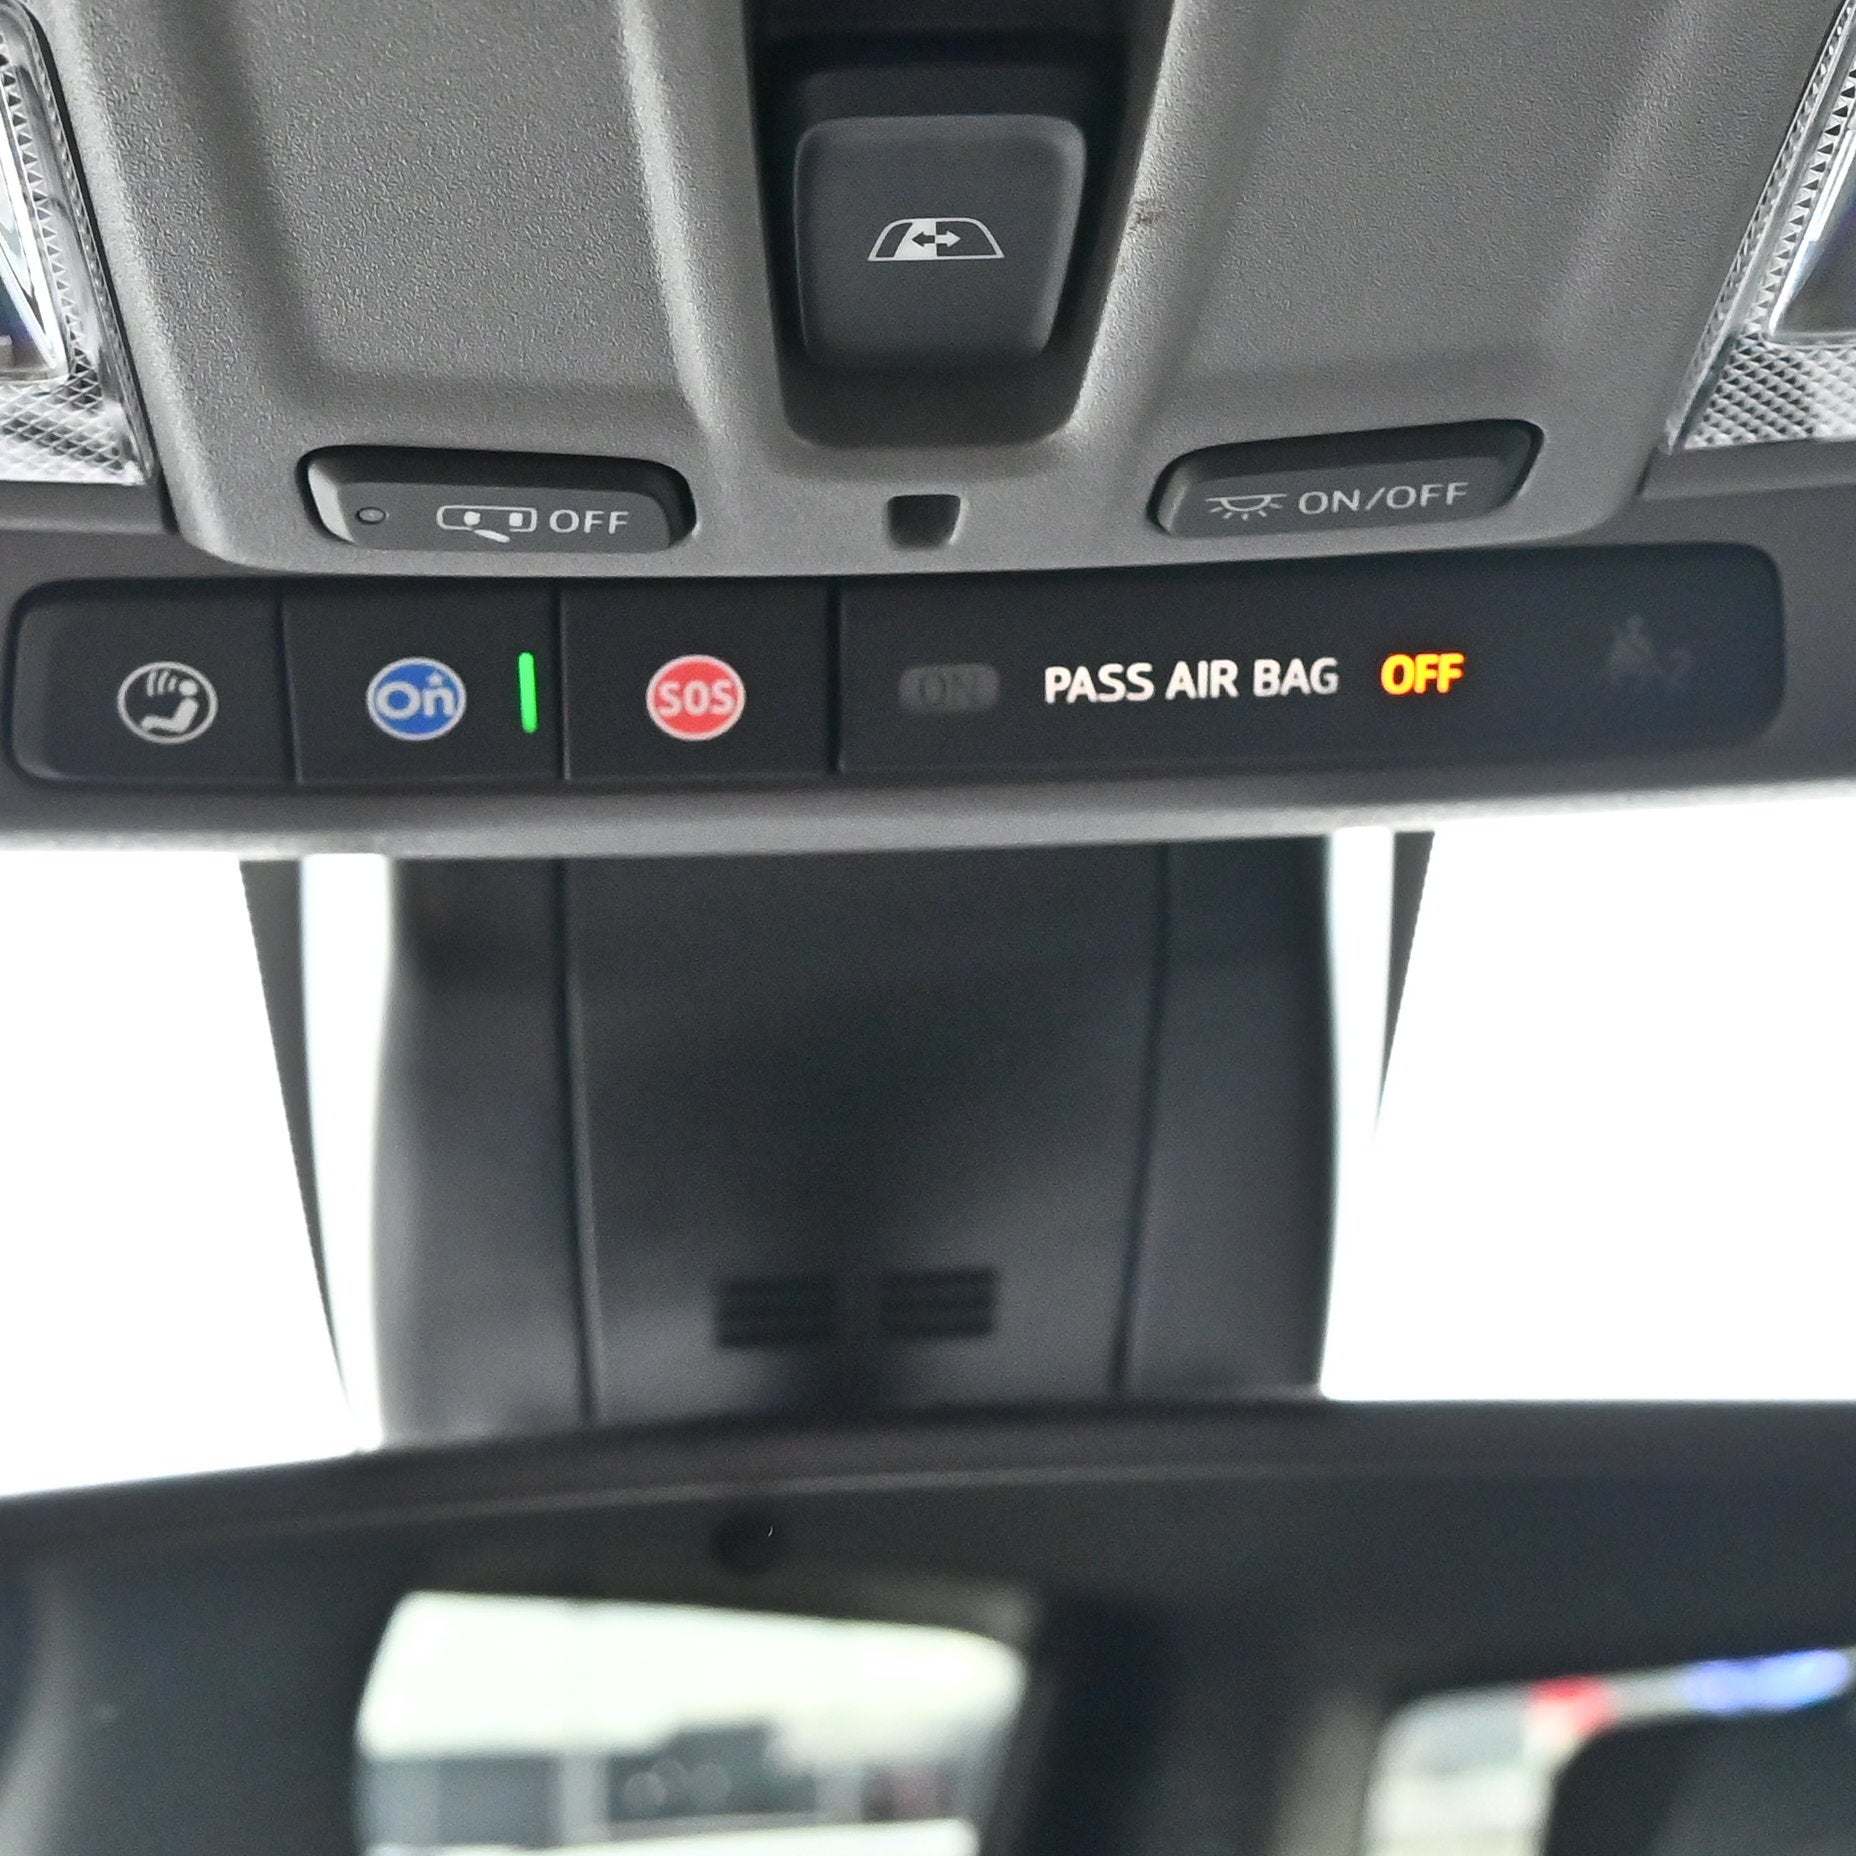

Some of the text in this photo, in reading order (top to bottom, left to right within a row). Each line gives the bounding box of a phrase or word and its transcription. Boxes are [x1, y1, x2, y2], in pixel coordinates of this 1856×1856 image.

[1297, 481, 1469, 516] ON/OFF
[548, 508, 630, 535] OFF
[375, 672, 456, 719] On
[1043, 651, 1466, 705] PASS AIR BAG OFF
[658, 680, 735, 716] SOS
